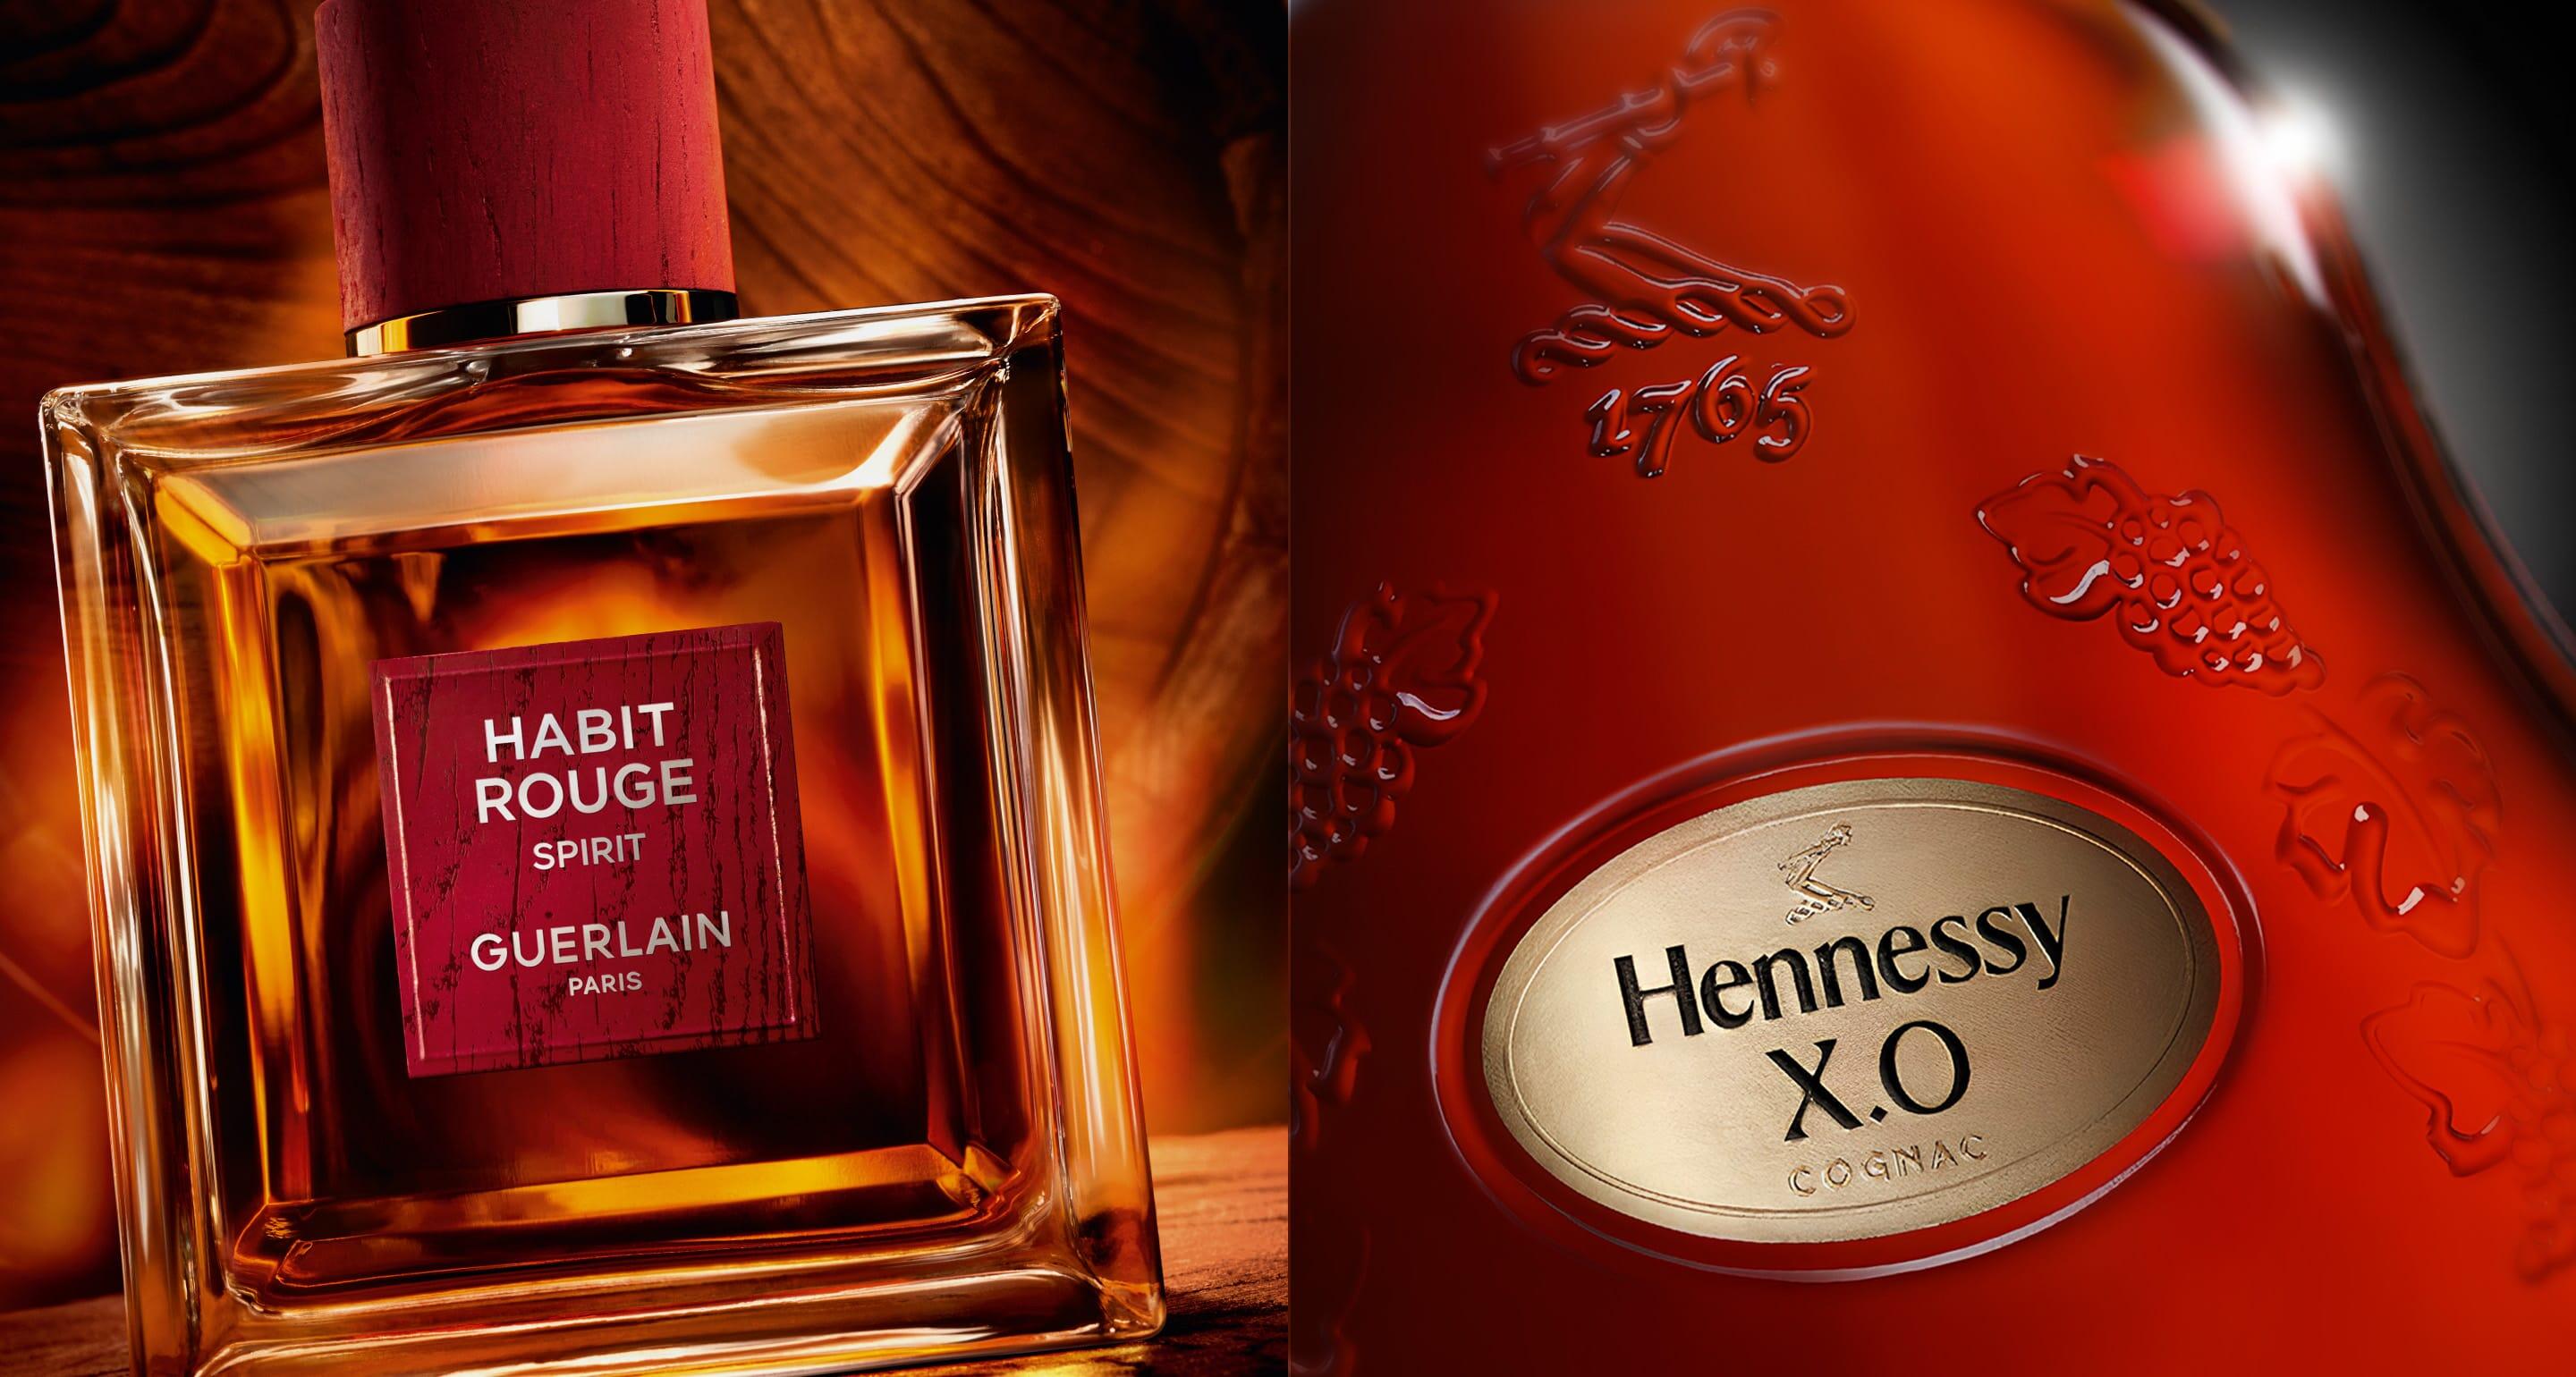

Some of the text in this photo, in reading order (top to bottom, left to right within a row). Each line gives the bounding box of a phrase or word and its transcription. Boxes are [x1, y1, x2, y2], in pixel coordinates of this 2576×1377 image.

[1585, 355, 1814, 477] 1765
[483, 701, 675, 764] HABIT
[475, 757, 698, 823] ROUGE
[532, 832, 645, 871] SPIRIT
[470, 910, 732, 972] GUERLAIN
[1614, 894, 2072, 1047] Hennessy
[568, 971, 642, 996] PARIS
[1766, 1020, 1972, 1141] X.O
[1787, 1135, 1988, 1196] COGNAC
